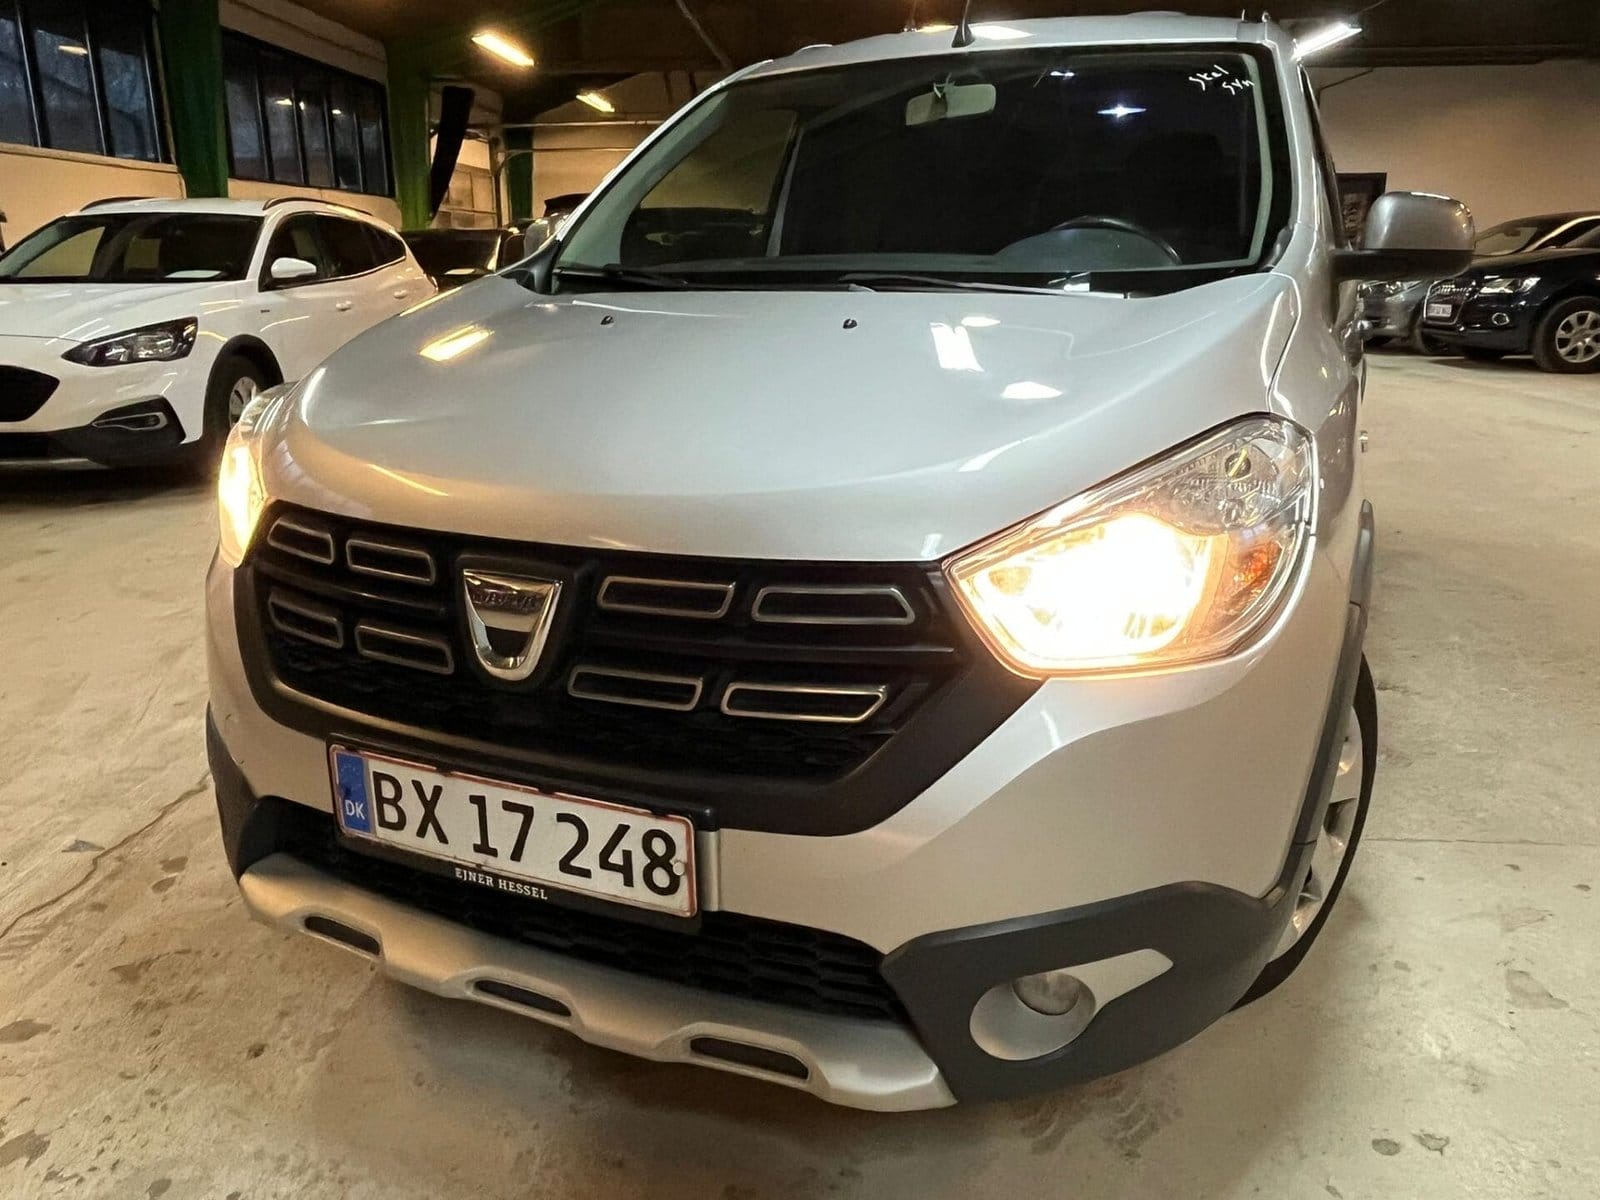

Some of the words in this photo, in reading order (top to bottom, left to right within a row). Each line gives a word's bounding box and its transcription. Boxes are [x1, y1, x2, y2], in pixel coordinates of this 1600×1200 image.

[345, 800, 365, 820] DK
[372, 770, 449, 845] BX
[468, 794, 534, 862] 17
[556, 812, 681, 896] 248
[454, 867, 494, 887] EJNER
[498, 879, 548, 900] HESSEL
